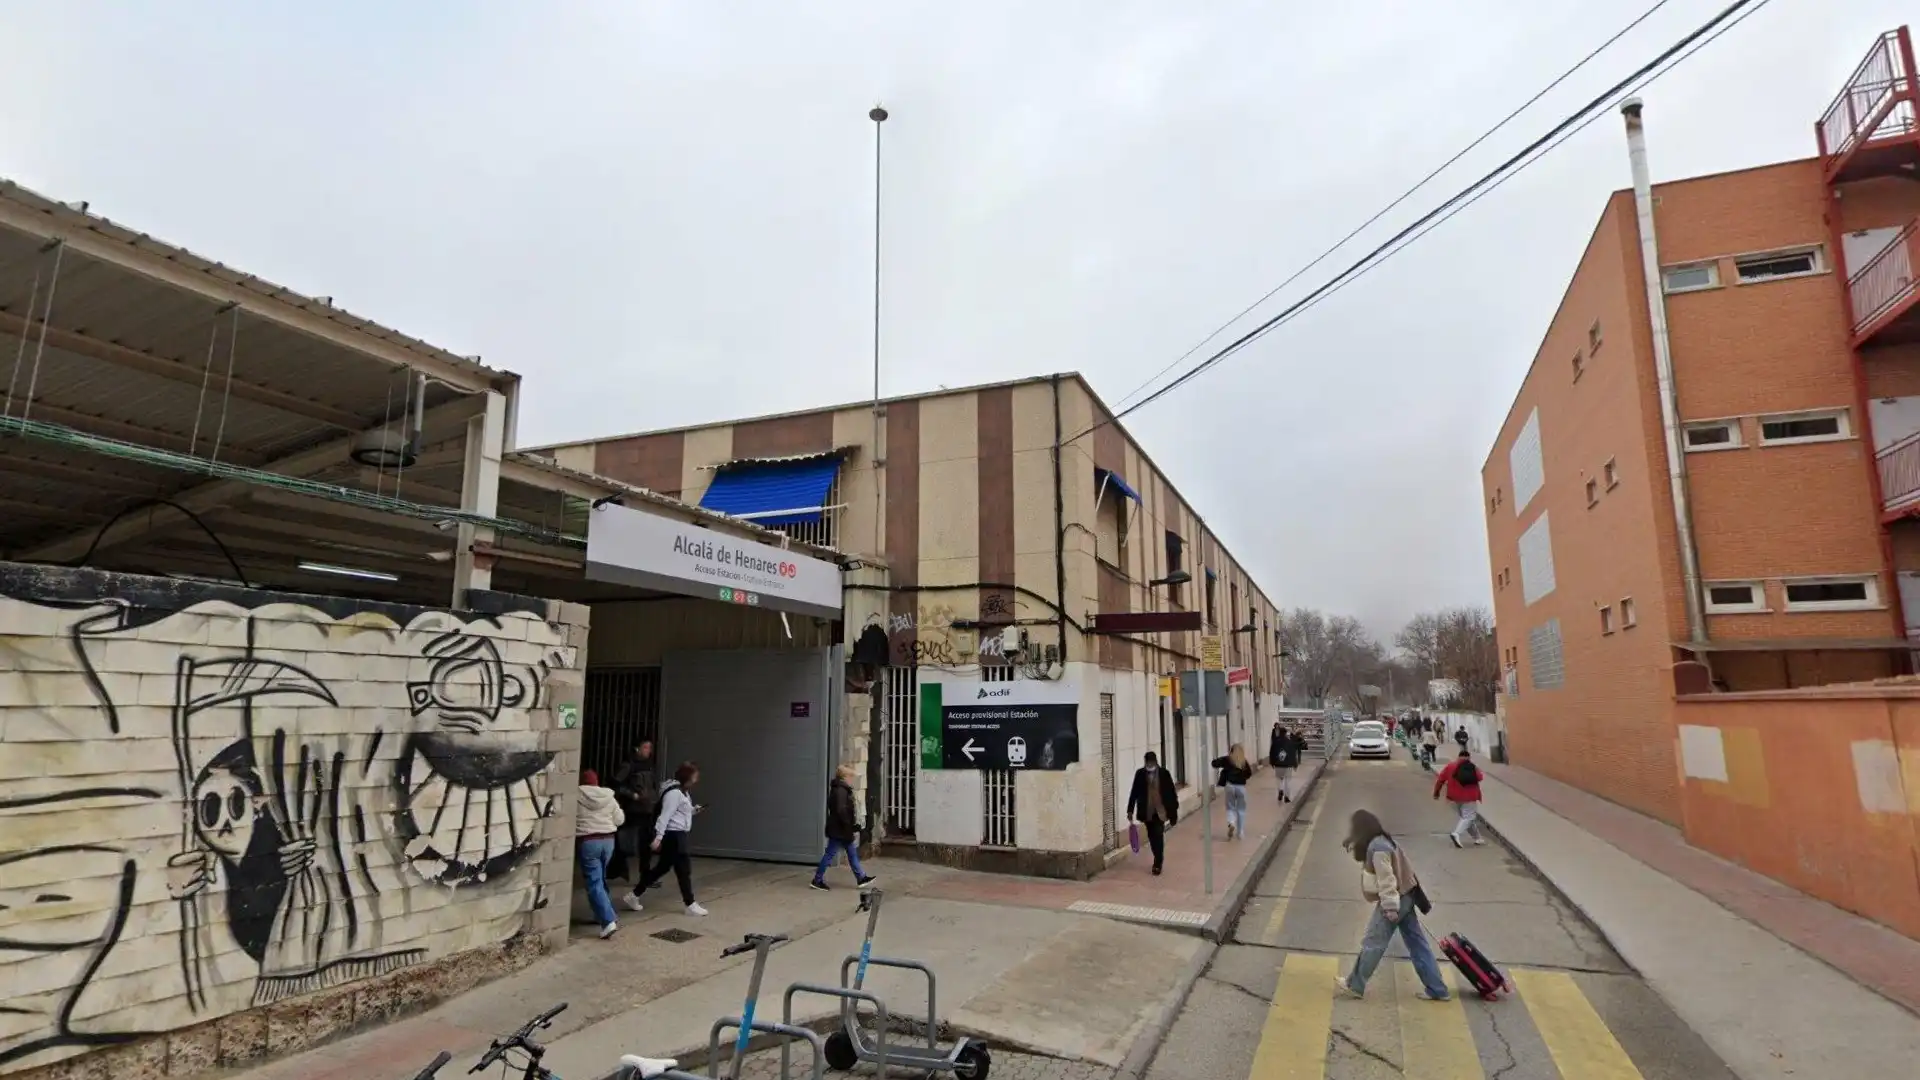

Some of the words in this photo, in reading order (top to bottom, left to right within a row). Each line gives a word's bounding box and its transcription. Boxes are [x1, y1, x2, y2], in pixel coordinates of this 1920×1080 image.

[673, 535, 713, 560] Alcalá
[717, 545, 732, 564] de
[735, 549, 777, 575] Henares
[694, 563, 716, 575] Acceso
[989, 688, 1011, 697] adif
[948, 711, 970, 719] Acceso
[971, 710, 1009, 720] provisional
[1010, 709, 1039, 719] Estación
